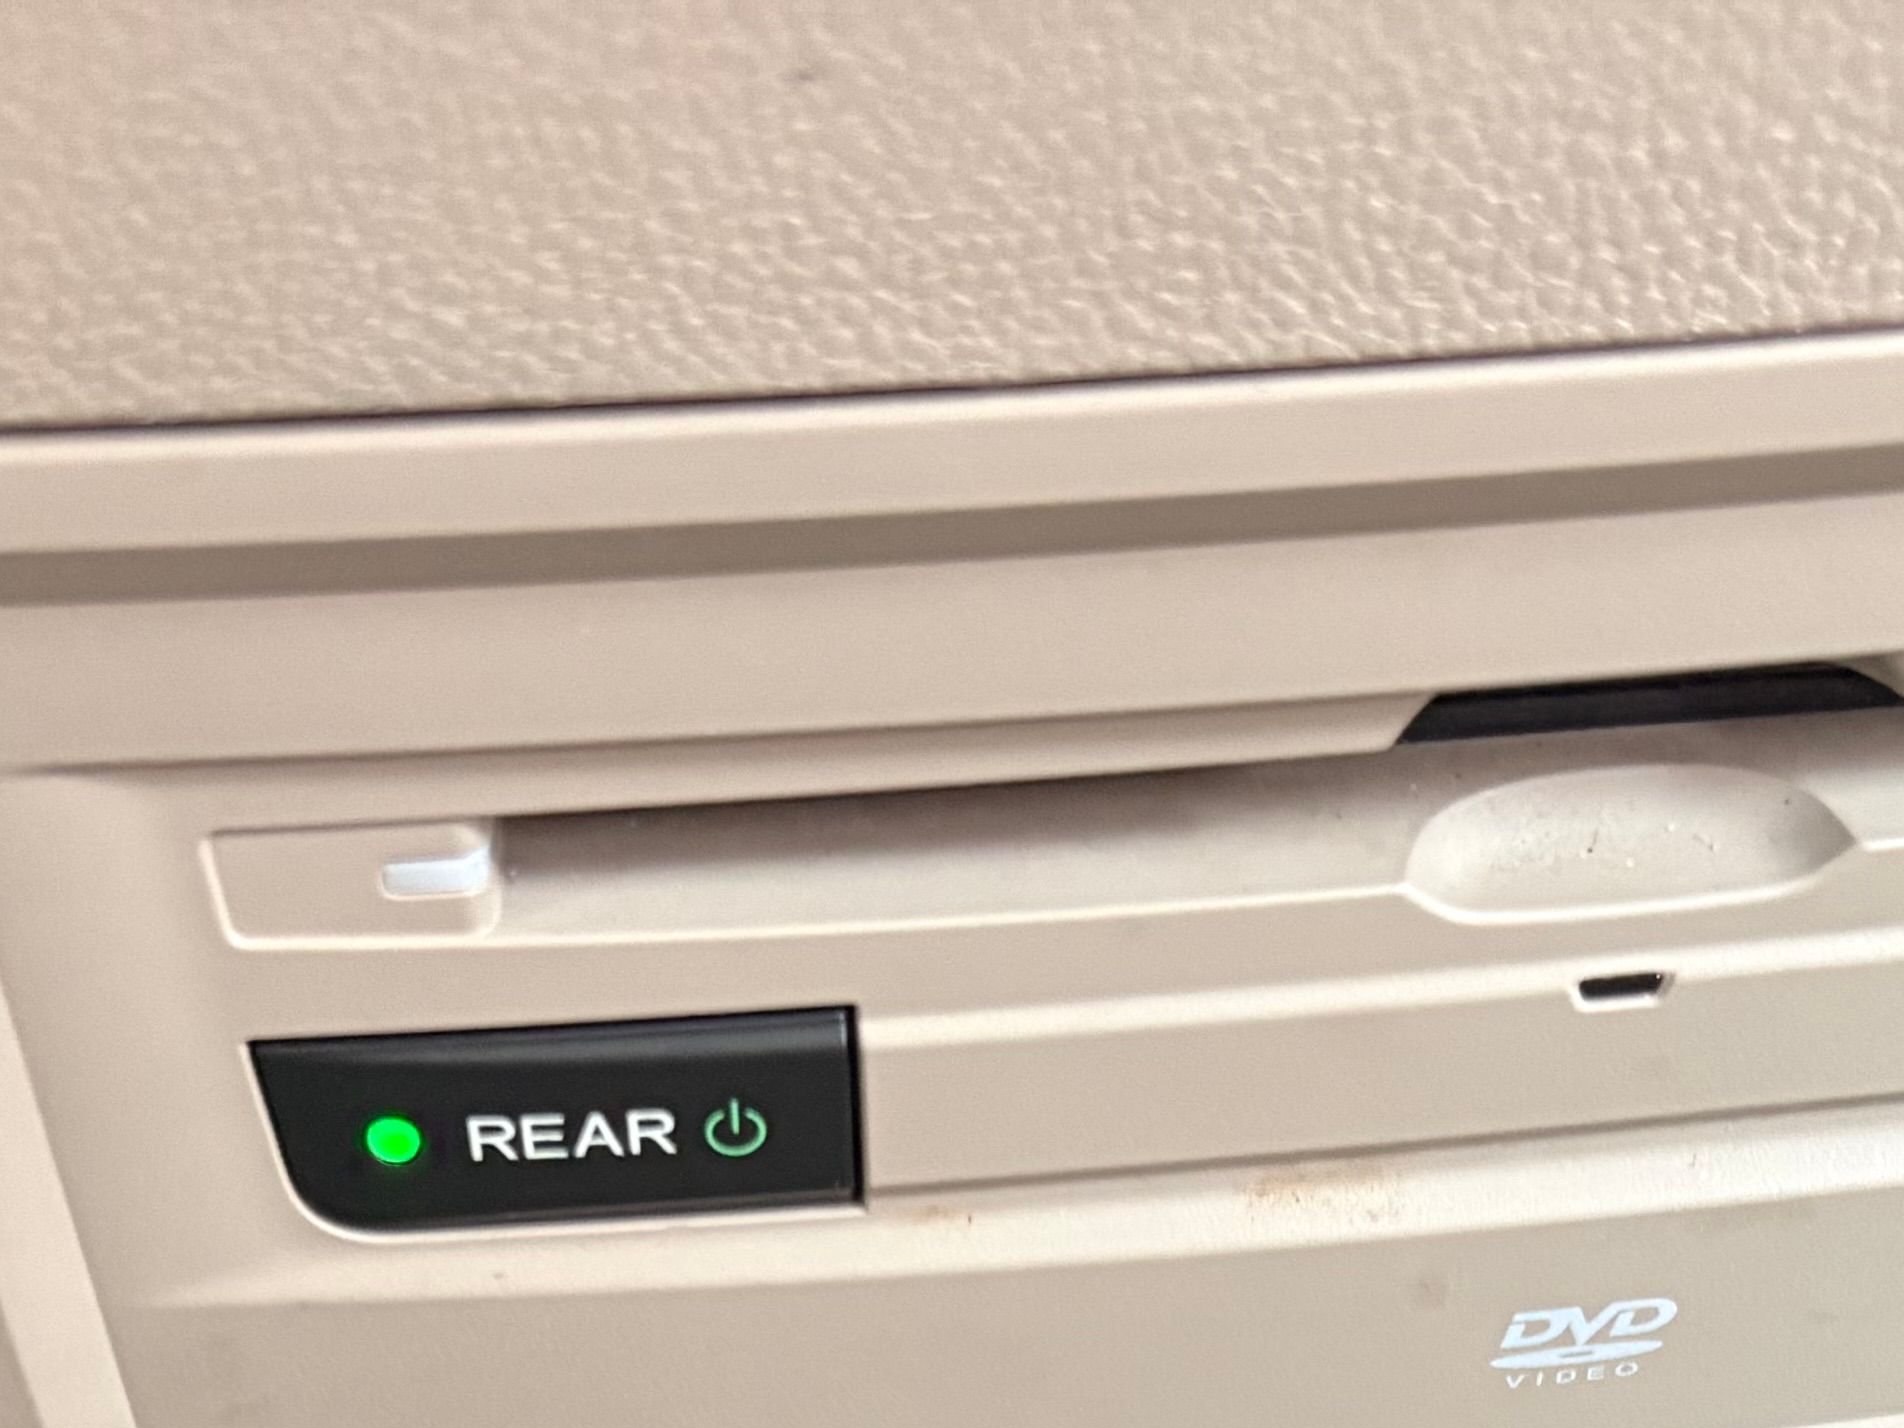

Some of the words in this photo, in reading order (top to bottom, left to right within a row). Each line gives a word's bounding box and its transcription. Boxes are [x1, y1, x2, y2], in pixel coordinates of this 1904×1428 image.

[465, 1107, 678, 1163] REAR
[1499, 1296, 1679, 1347] DVD
[1503, 1360, 1640, 1390] VIDEO
